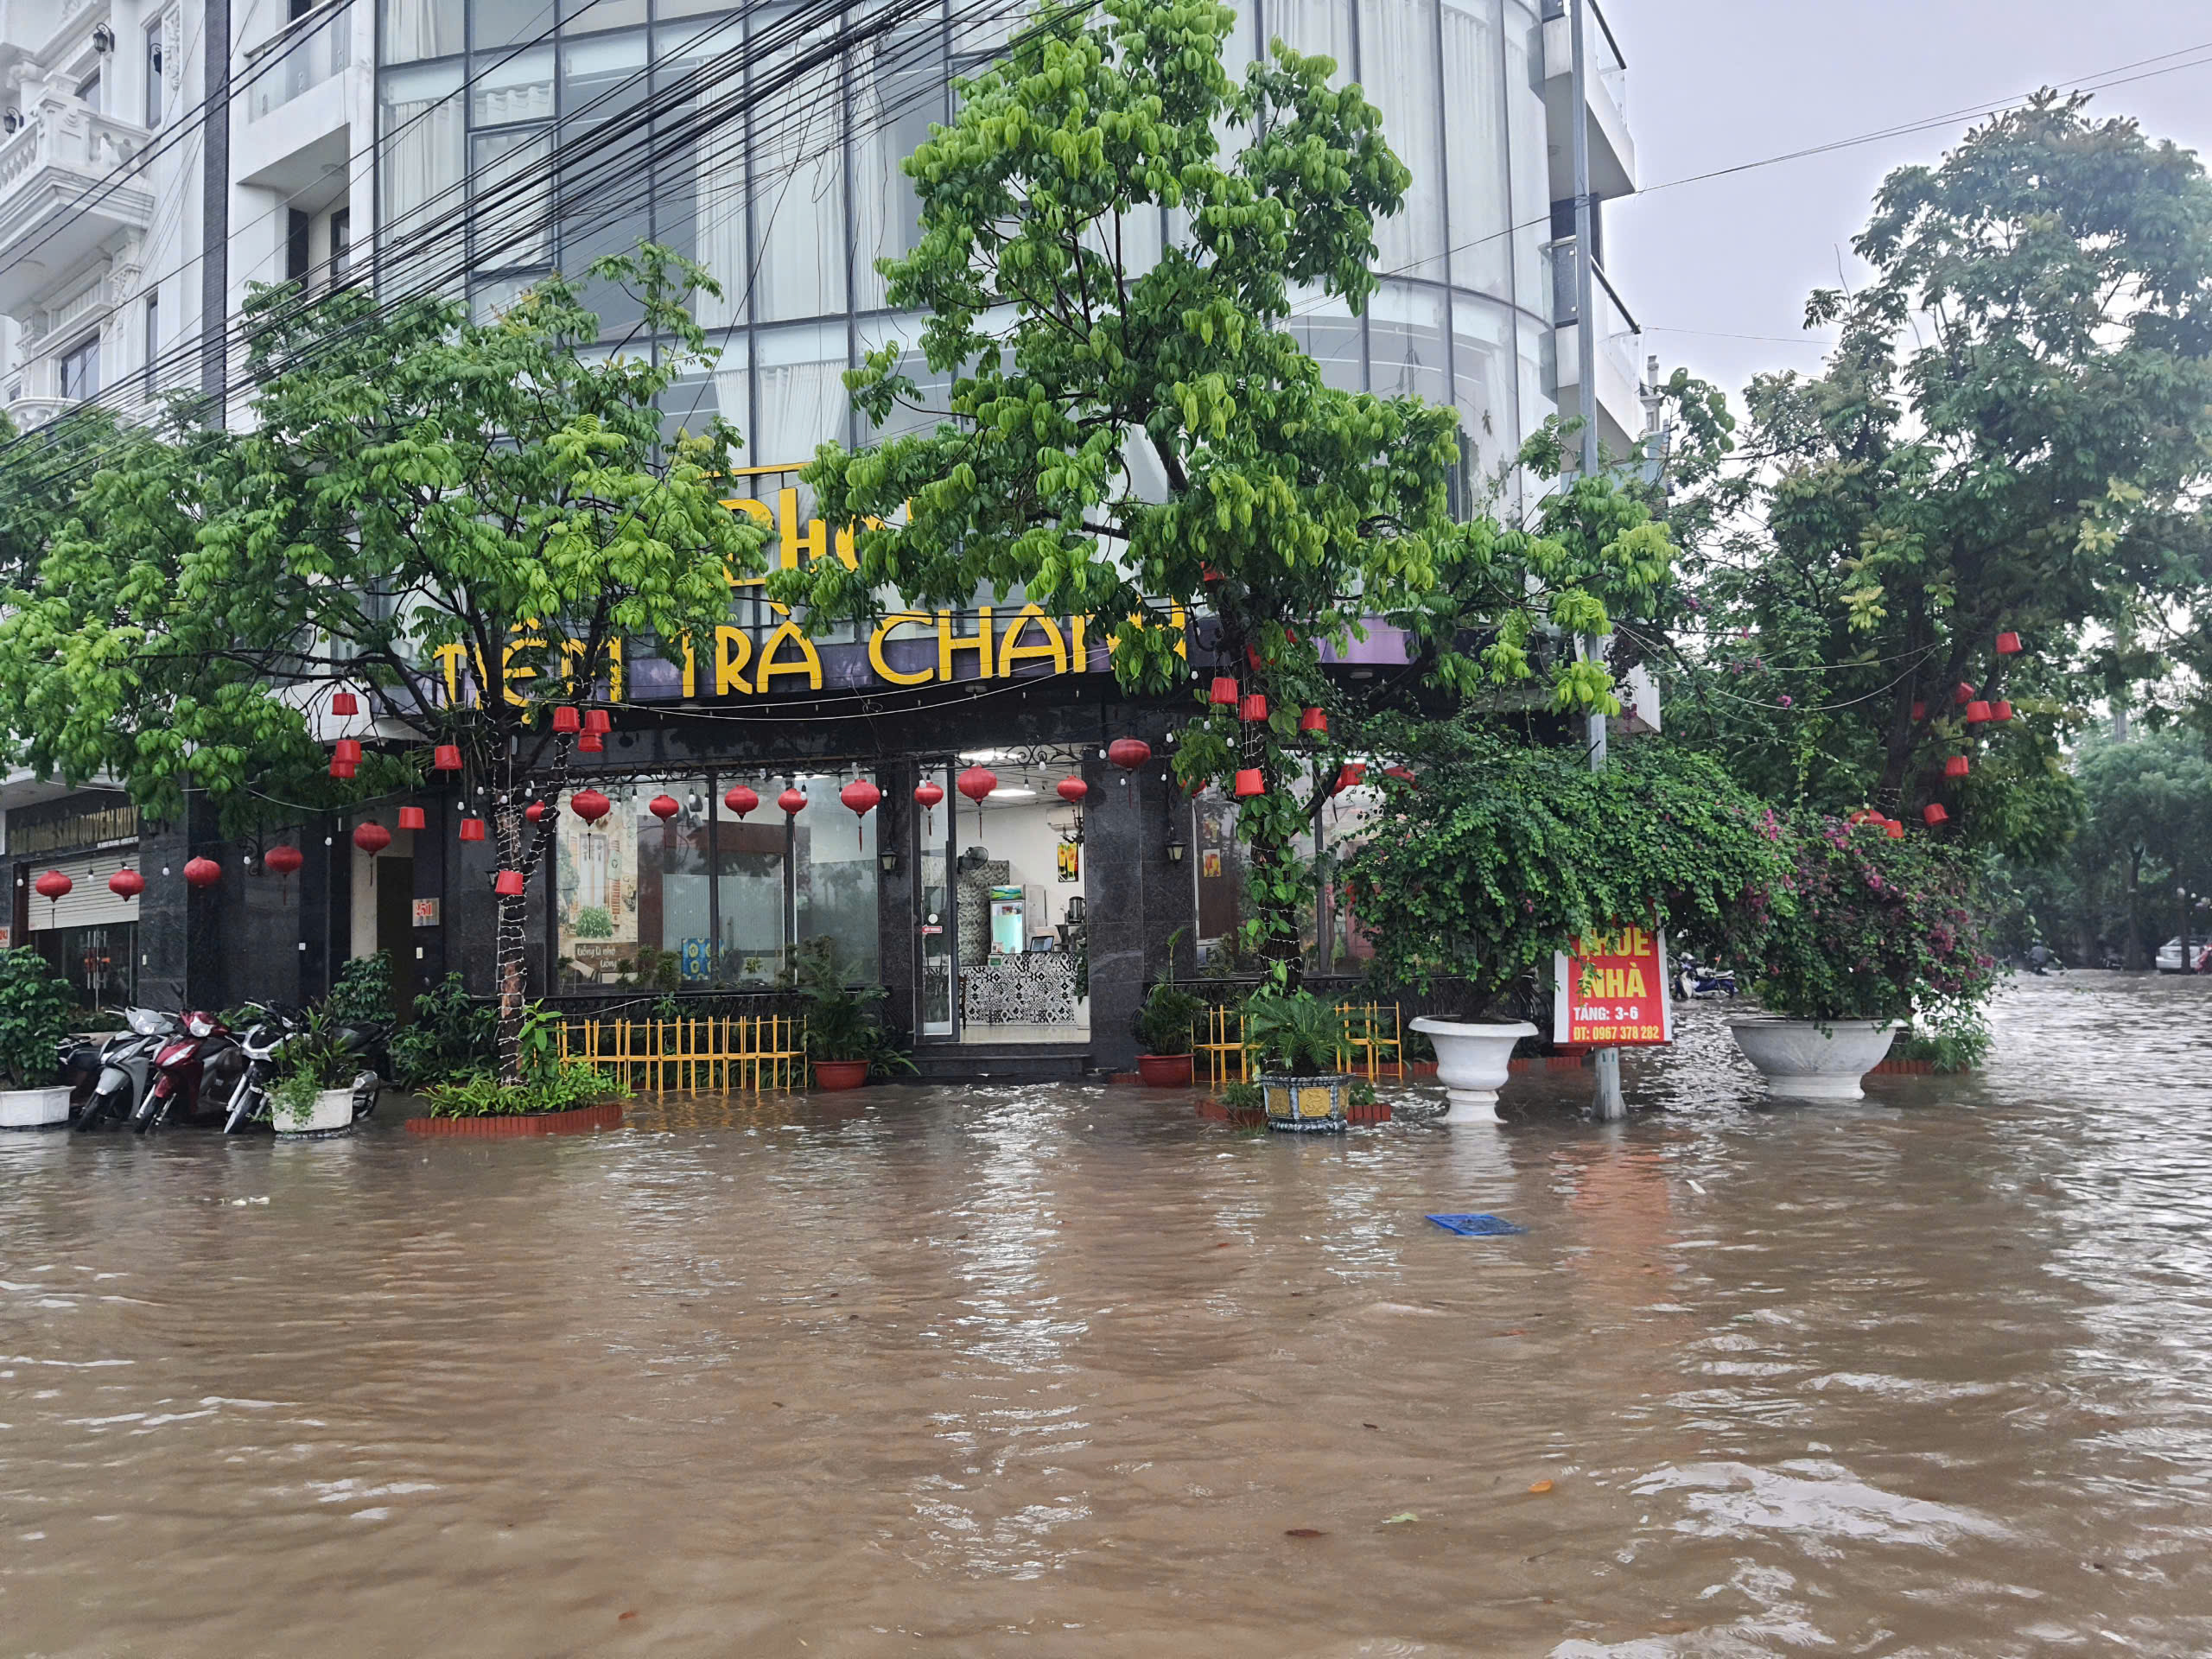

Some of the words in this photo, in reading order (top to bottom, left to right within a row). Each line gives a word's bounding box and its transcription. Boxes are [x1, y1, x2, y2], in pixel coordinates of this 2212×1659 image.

[1582, 962, 1647, 999] NHÀ
[1614, 1006, 1639, 1020] 3-6
[1592, 1026, 1618, 1040] 0967
[1619, 1026, 1639, 1040] 378
[1641, 1025, 1660, 1039] 282
